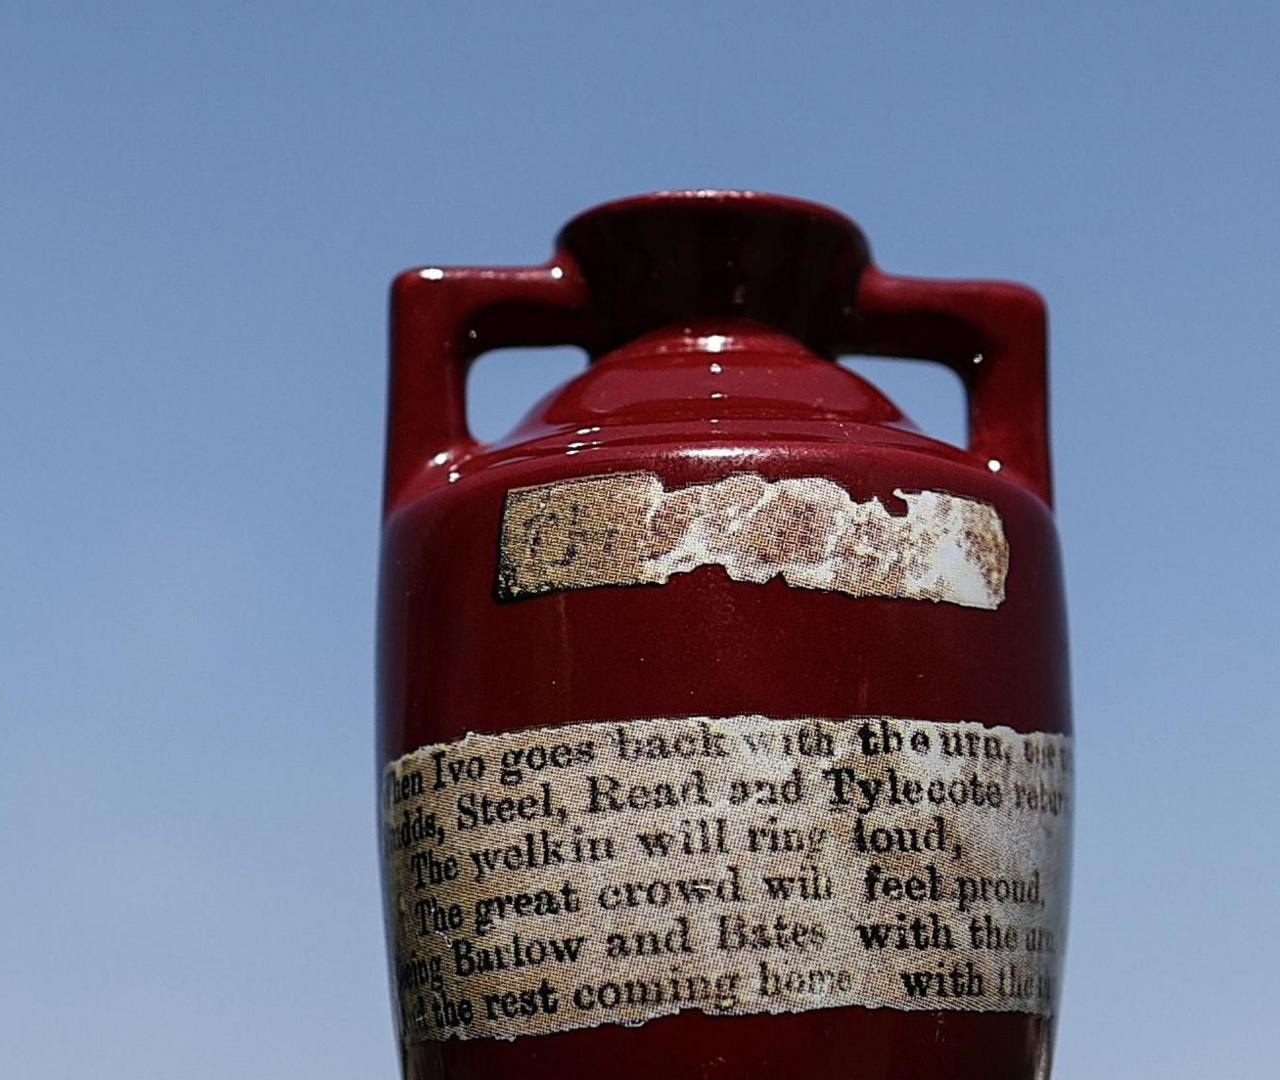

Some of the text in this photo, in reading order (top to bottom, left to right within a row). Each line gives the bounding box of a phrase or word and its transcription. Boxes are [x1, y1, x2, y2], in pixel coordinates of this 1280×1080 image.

[432, 751, 486, 791] Ivo
[500, 740, 594, 787] goes
[609, 722, 729, 760] back
[858, 720, 931, 756] the
[457, 783, 567, 833] Steel,
[586, 769, 712, 814] Read
[730, 767, 803, 806] and
[823, 767, 1003, 815] Tylecote
[411, 849, 458, 890] The
[635, 818, 728, 856] will
[853, 816, 962, 861] loud,
[415, 897, 463, 936] The
[475, 882, 580, 936] great
[599, 865, 745, 910] crowd
[865, 864, 944, 900] feel
[452, 935, 584, 977] Barlow
[606, 915, 693, 957] and
[719, 914, 825, 951] Bates
[855, 912, 960, 950] with
[968, 914, 1019, 950] the
[432, 991, 473, 1028] the
[484, 977, 558, 1021] rest
[573, 965, 738, 1011] coming
[899, 961, 984, 998] with
